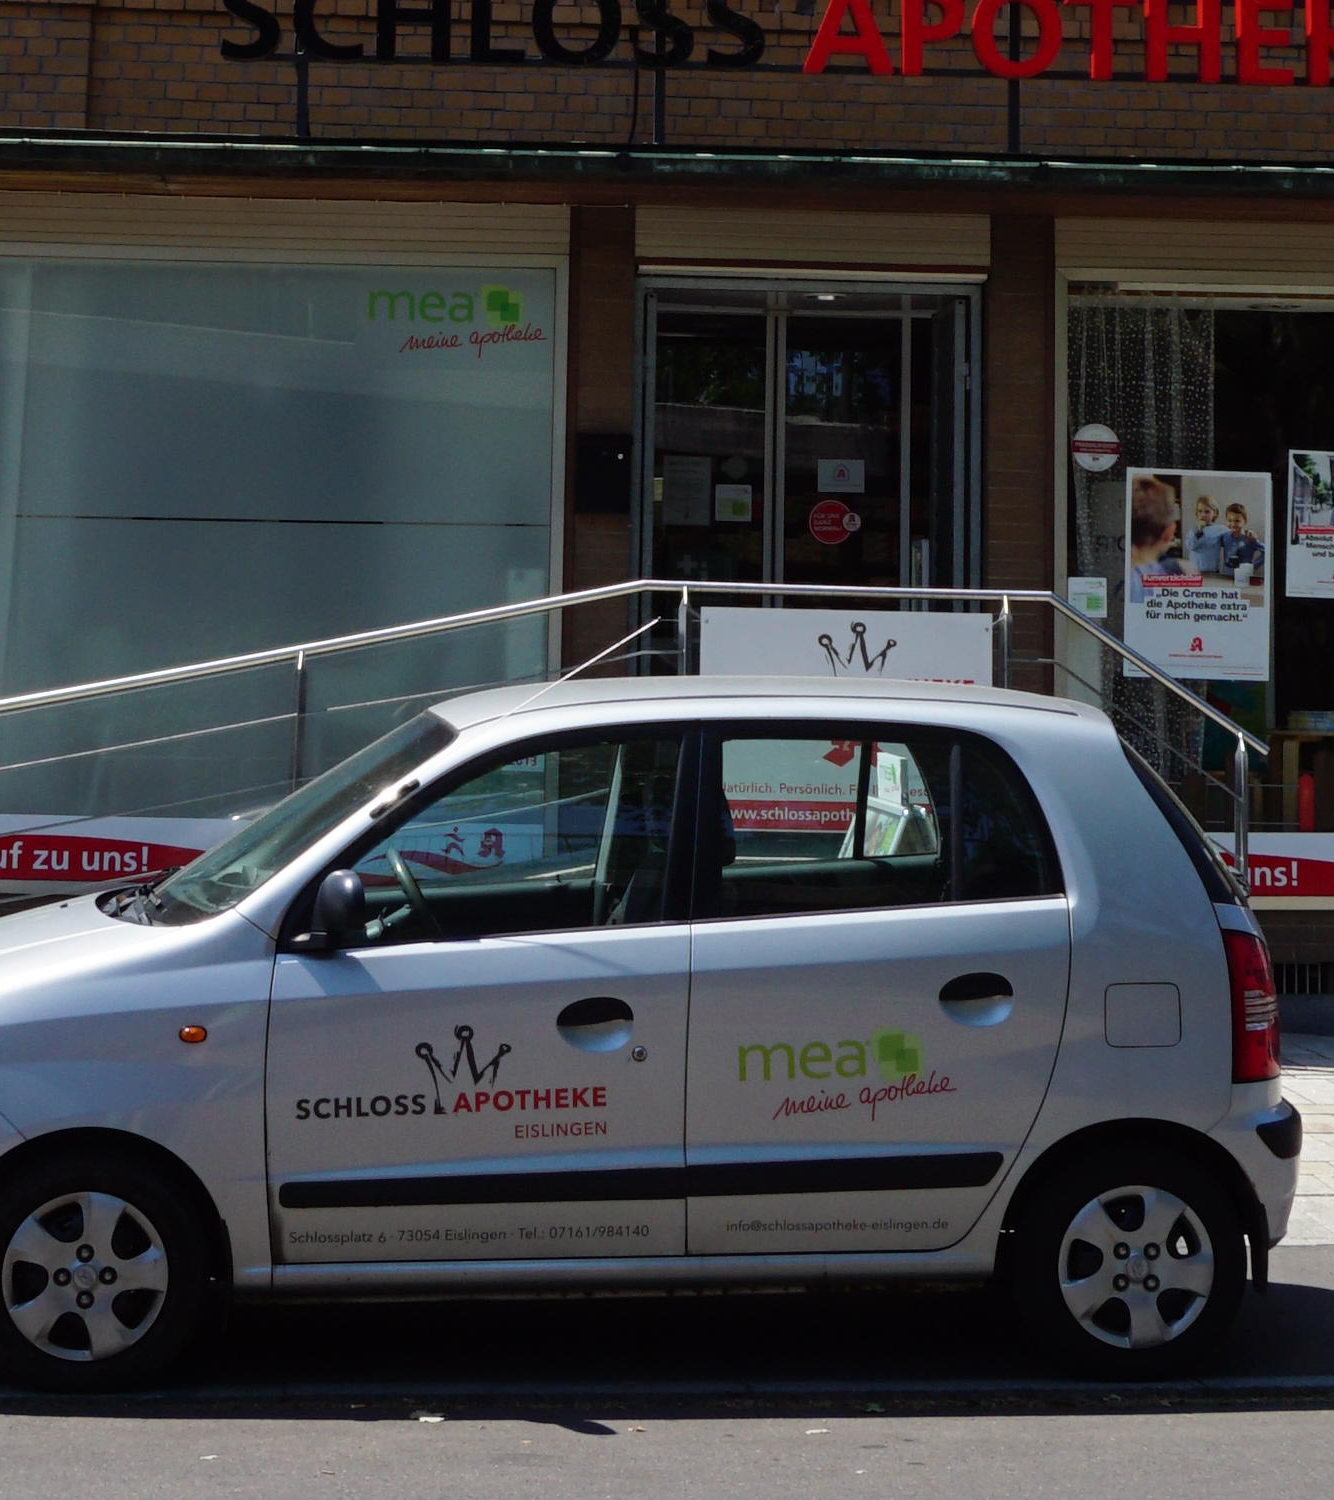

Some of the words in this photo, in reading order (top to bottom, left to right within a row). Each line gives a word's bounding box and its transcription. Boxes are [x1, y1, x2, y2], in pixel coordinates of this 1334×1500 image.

[367, 289, 475, 323] mea
[400, 331, 463, 353] meine
[469, 322, 548, 359] apotheke
[1146, 599, 1163, 608] die
[1166, 600, 1218, 611] Apotheke
[1220, 602, 1248, 611] extra
[1182, 589, 1219, 599] Creme
[1221, 590, 1239, 600] hat
[1145, 610, 1161, 620] für
[1164, 611, 1191, 620] mich
[32, 849, 70, 871] zu
[81, 845, 150, 873] uns!
[738, 1039, 868, 1082] mea
[295, 1093, 427, 1121] SCHLOSS
[453, 1086, 608, 1113] APOTHEKE
[772, 1089, 852, 1121] meine
[858, 1070, 957, 1122] apotheke
[514, 1121, 608, 1140] EISLINGEN
[288, 1230, 375, 1246] Schlossplatz
[378, 1231, 388, 1244] 6
[397, 1229, 442, 1243] 73054
[445, 1228, 508, 1244] Eislingen
[548, 1224, 651, 1241] 07161/984140
[725, 1218, 950, 1234] info@schlossapotheke-eislingen.de
